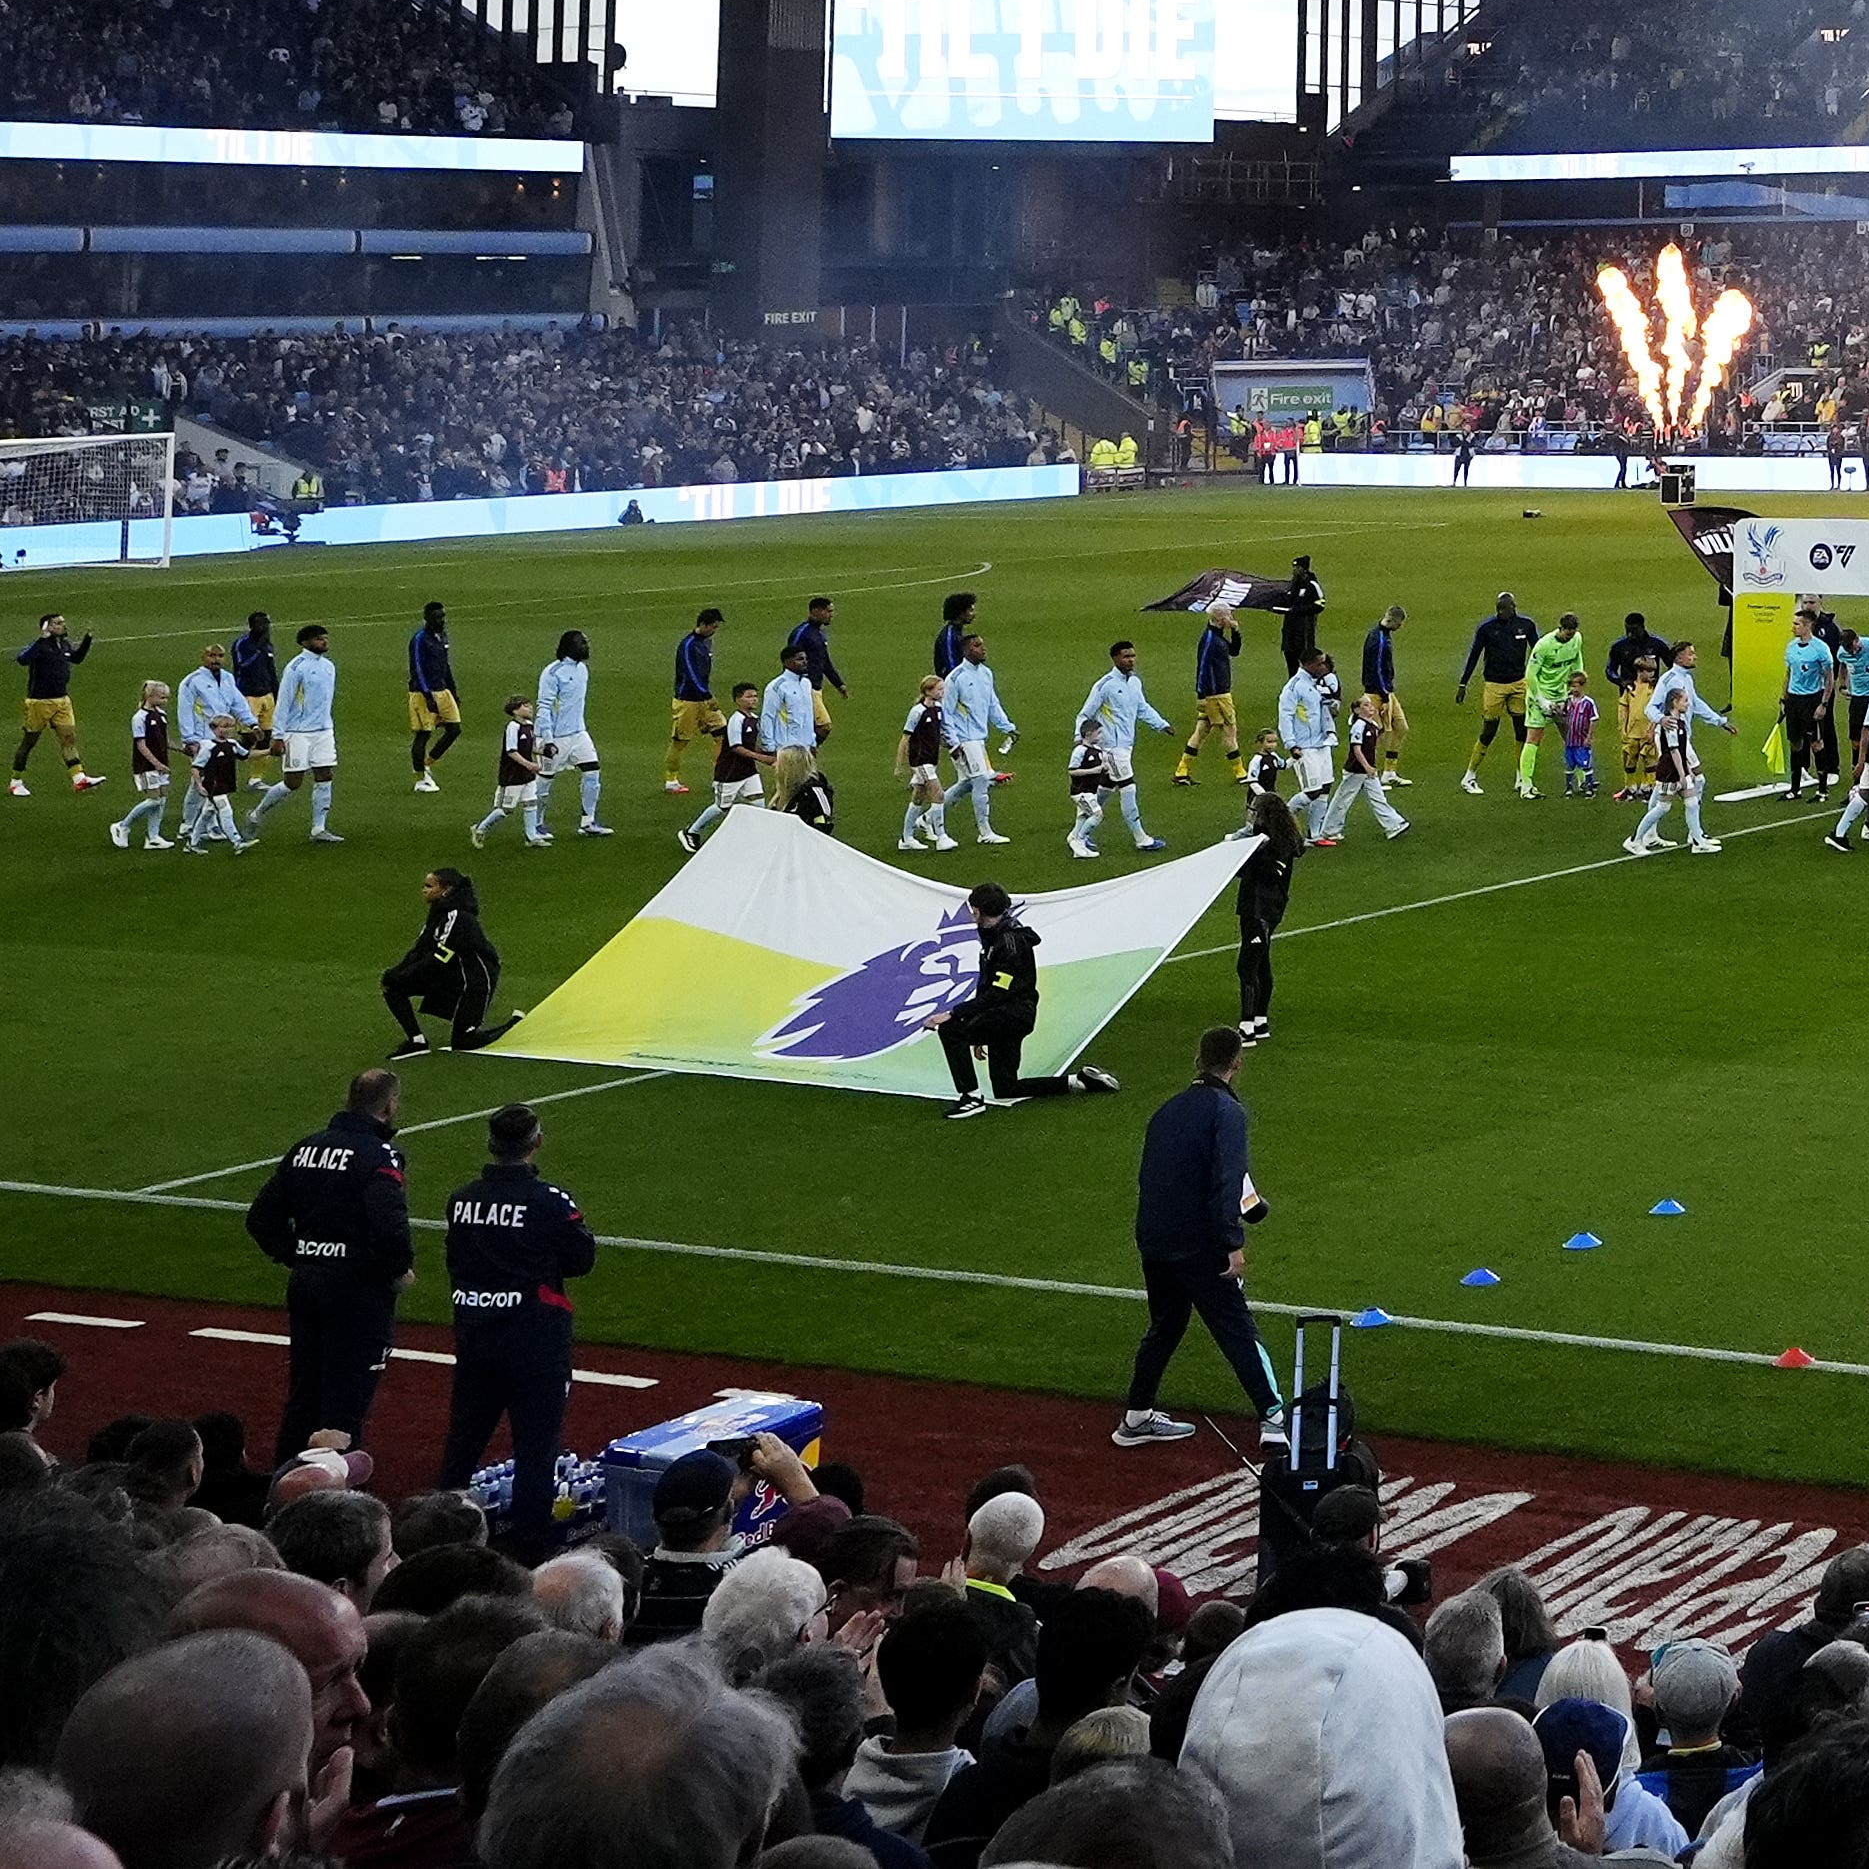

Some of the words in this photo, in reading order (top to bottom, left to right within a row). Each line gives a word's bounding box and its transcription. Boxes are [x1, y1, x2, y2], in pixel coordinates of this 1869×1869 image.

[764, 312, 790, 325] FIRE
[792, 311, 818, 324] EXIT
[1270, 389, 1300, 405] Fire
[1302, 390, 1332, 405] exit
[118, 405, 140, 417] AD
[778, 478, 832, 514] DIE
[1813, 548, 1829, 560] EA
[292, 1146, 354, 1171] PALACE
[453, 1201, 528, 1228] PALACE
[295, 1239, 347, 1258] acron
[452, 1289, 522, 1308] macron
